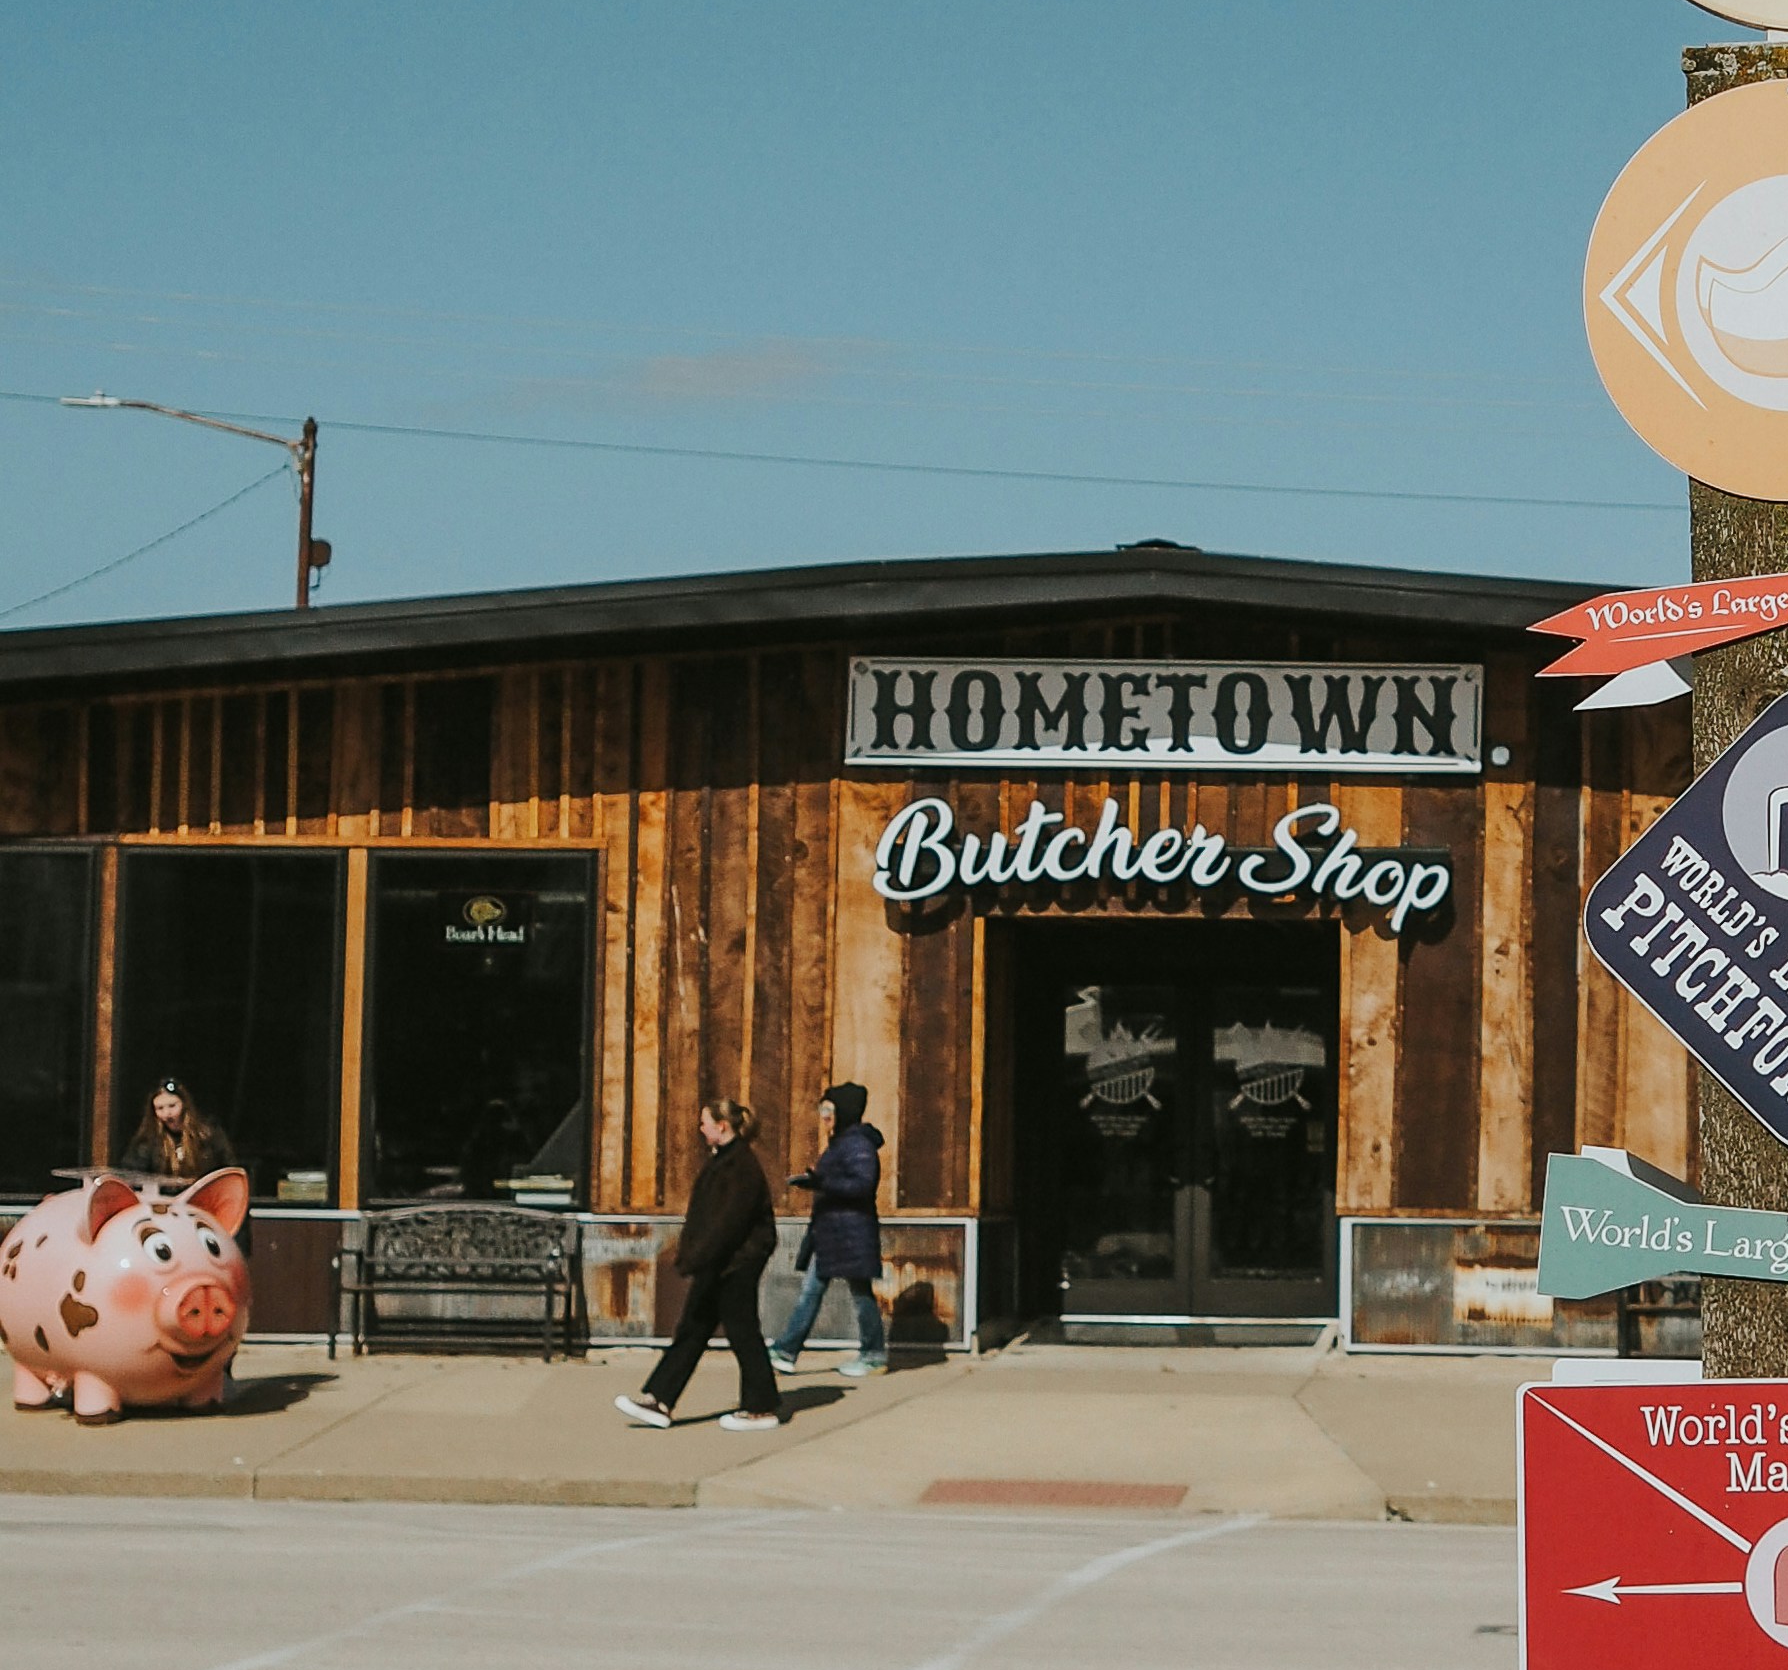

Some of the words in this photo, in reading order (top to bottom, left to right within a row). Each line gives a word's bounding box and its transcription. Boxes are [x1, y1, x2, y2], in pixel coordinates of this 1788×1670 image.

[1586, 594, 1703, 631] World's
[869, 669, 1458, 756] HOMETOWN
[872, 797, 1229, 901] Butcher
[1238, 802, 1450, 932] Shop
[1661, 835, 1779, 958] WORLD'S
[1560, 1206, 1693, 1253] World's
